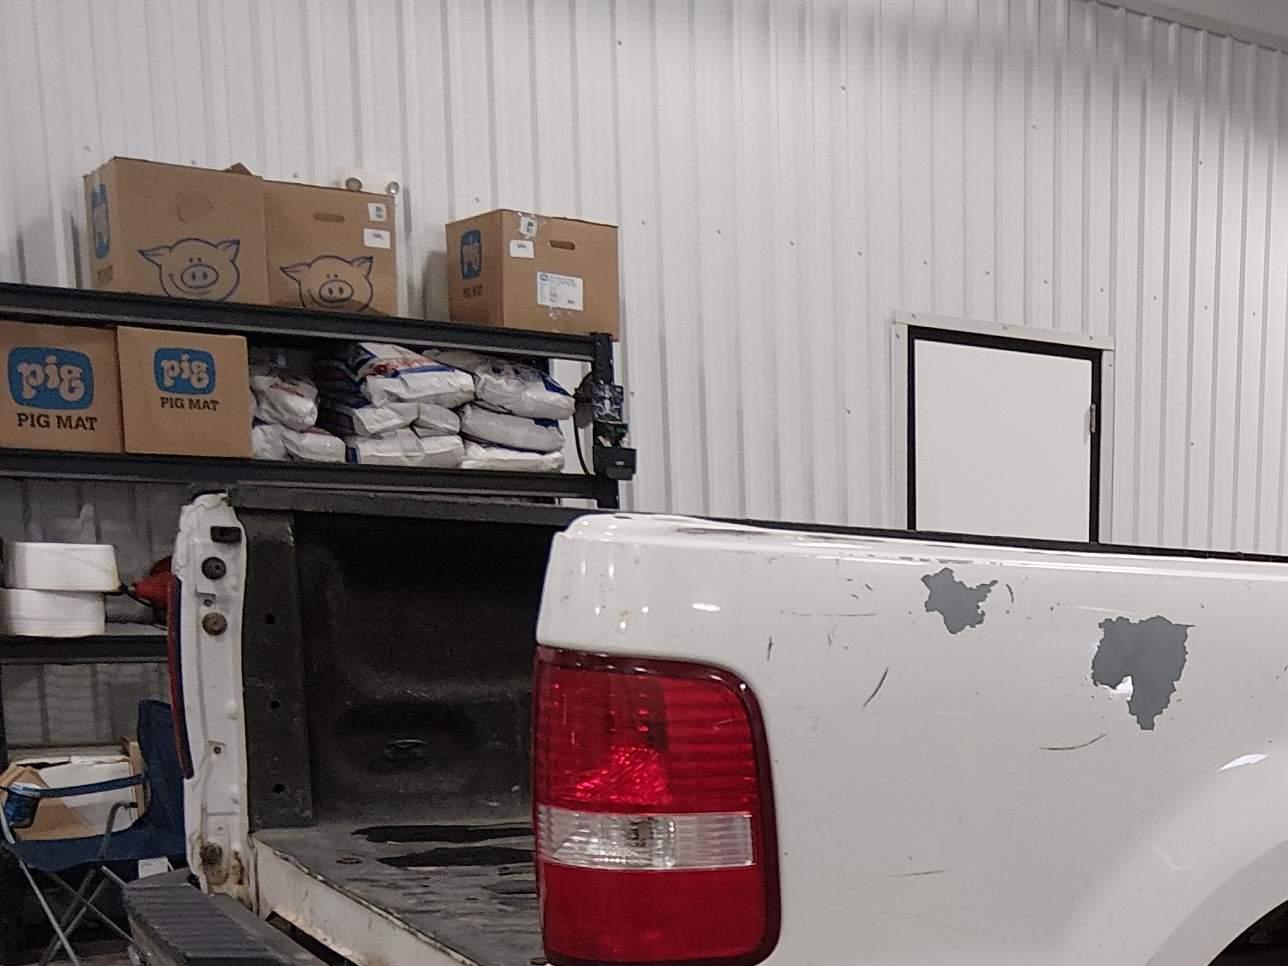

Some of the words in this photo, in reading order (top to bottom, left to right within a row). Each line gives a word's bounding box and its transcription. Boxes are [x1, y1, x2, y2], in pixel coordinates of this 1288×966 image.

[17, 354, 86, 402] pig
[160, 352, 210, 389] pig
[160, 396, 185, 409] PIG
[188, 398, 220, 412] MAT
[16, 412, 51, 429] PIG
[56, 414, 98, 431] MAT
